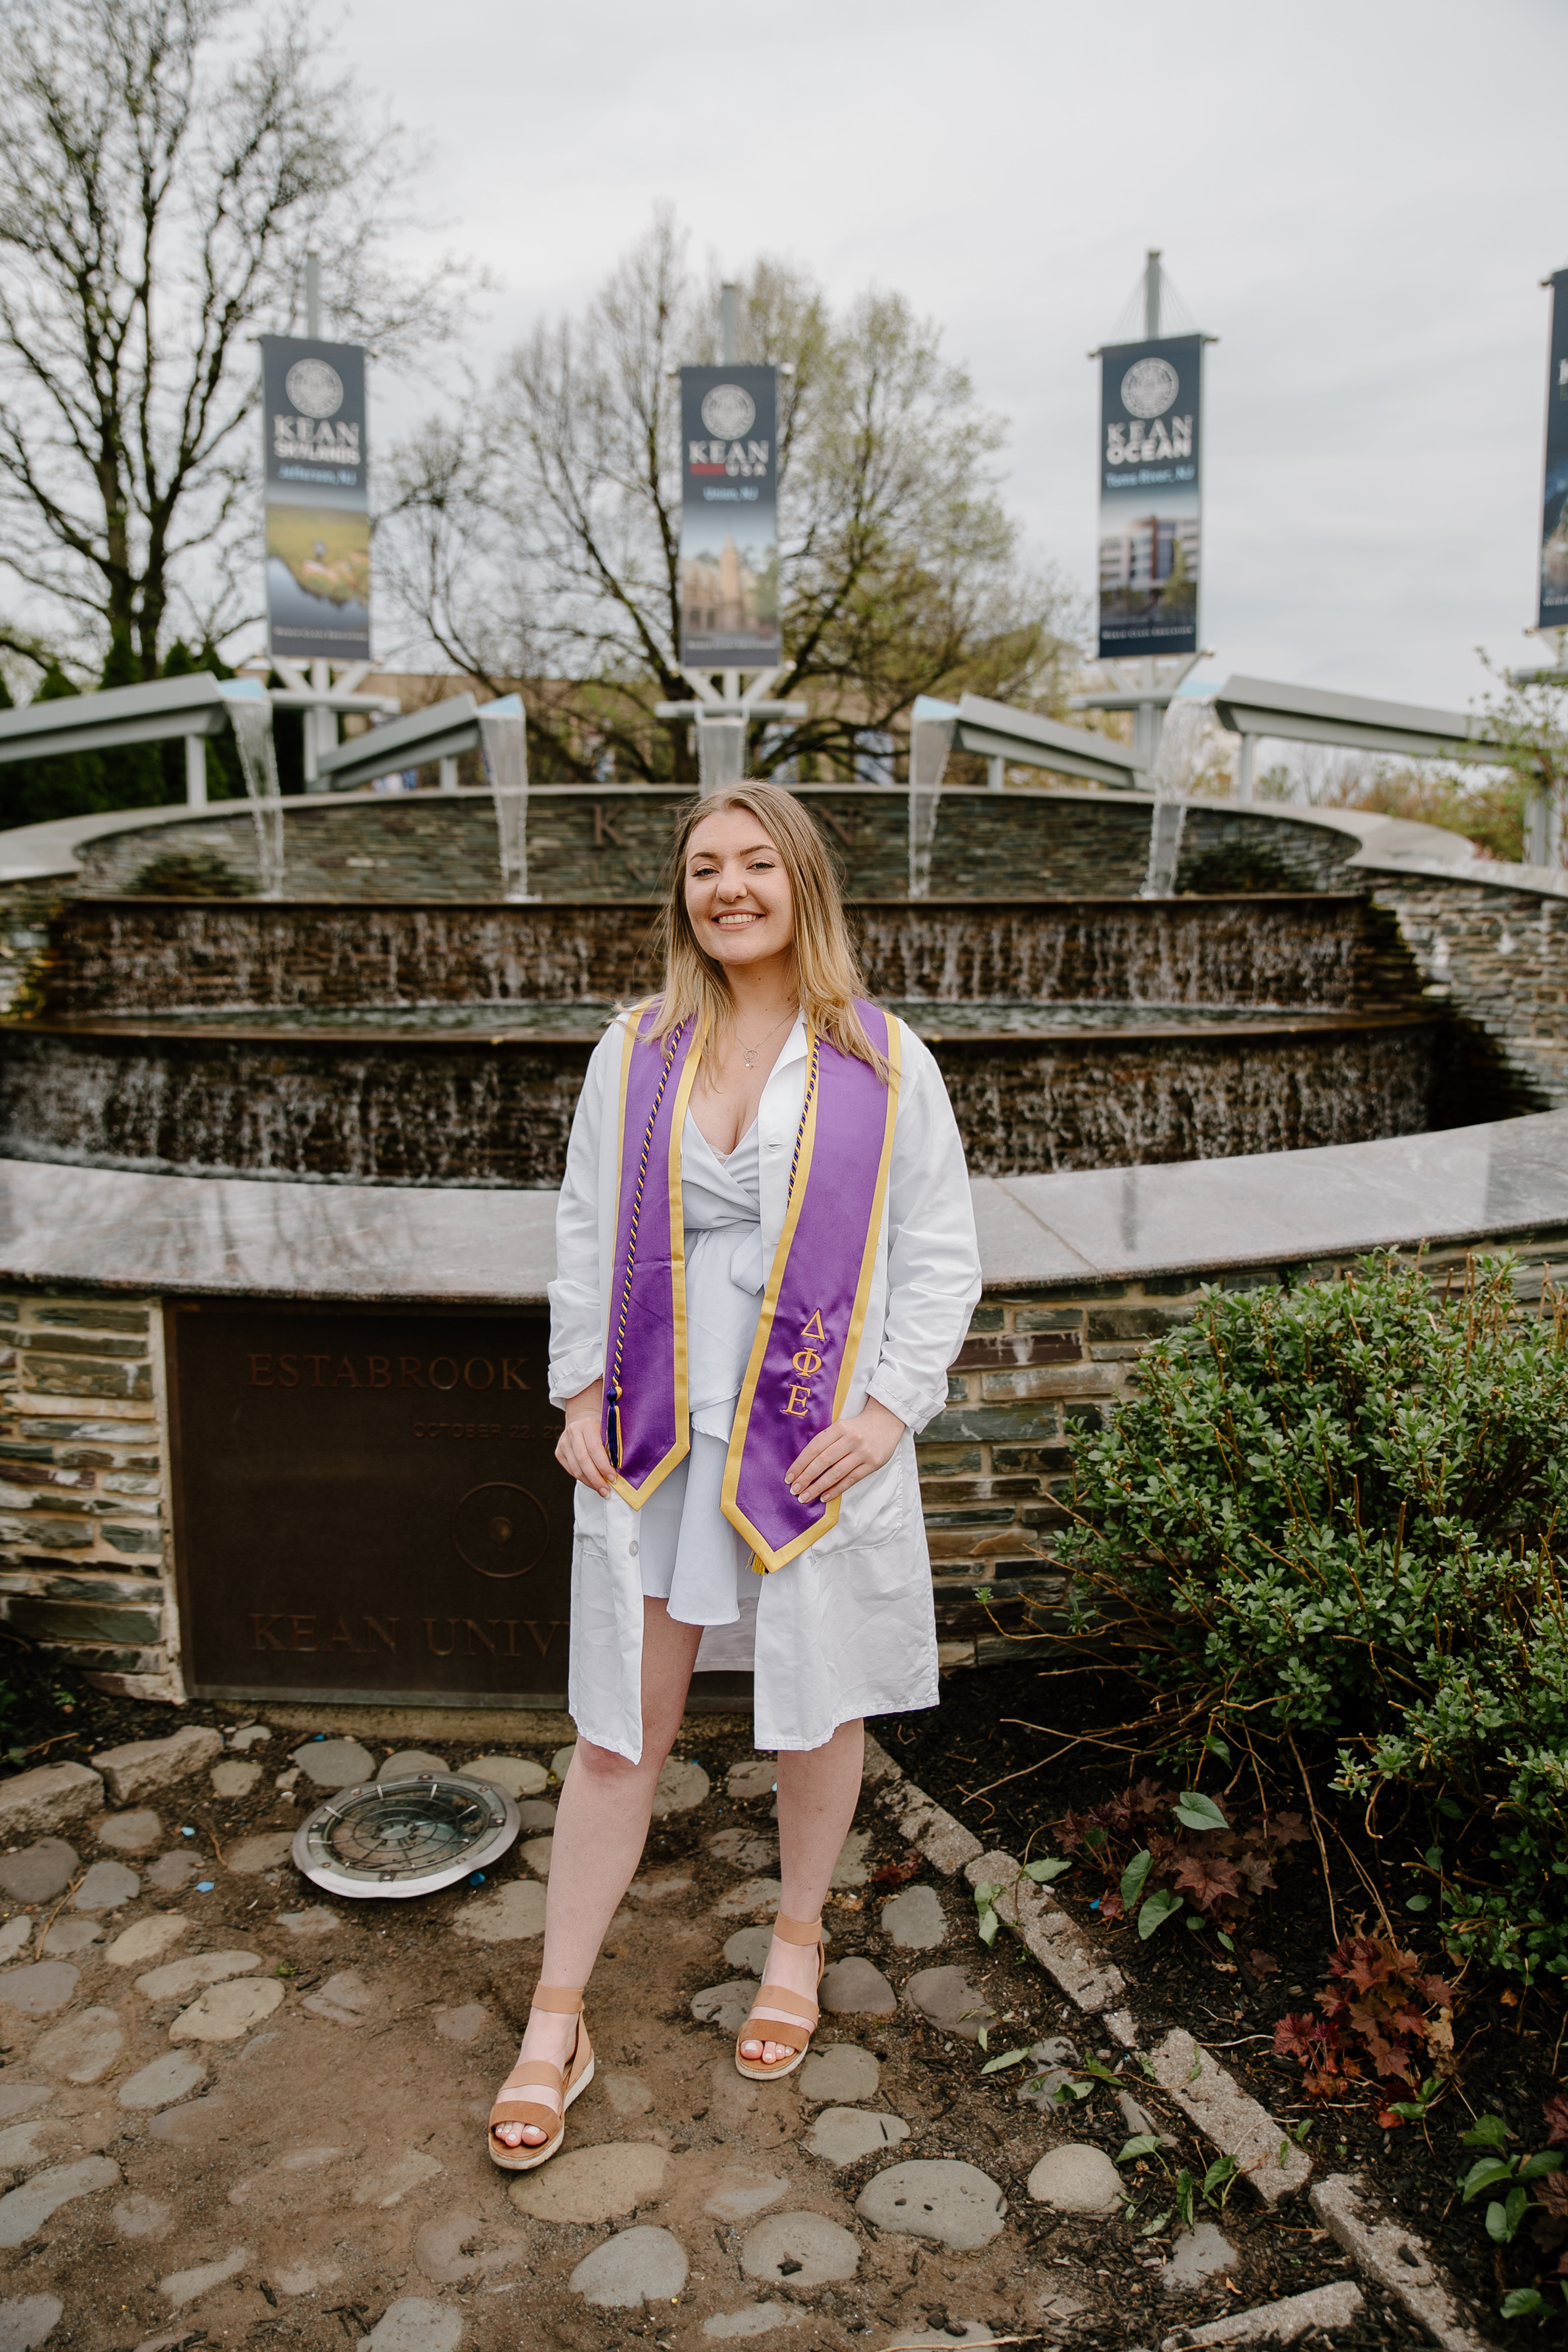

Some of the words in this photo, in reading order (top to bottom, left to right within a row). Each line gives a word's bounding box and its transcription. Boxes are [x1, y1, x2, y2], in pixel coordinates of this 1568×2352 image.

[274, 415, 359, 445] KEAN
[1108, 415, 1193, 444] KEAN
[274, 439, 360, 464] SKYLANDS
[689, 441, 768, 463] KEAN
[1107, 439, 1191, 464] OCEAN
[726, 463, 766, 476] USA
[1106, 473, 1137, 488] Toms
[1176, 465, 1194, 480] NJ
[248, 1354, 532, 1390] ESTABROOK
[414, 1422, 501, 1439] OCTOBER
[543, 1425, 564, 1439] 20
[249, 1612, 400, 1654] KEAN
[422, 1617, 571, 1657] UNIV
